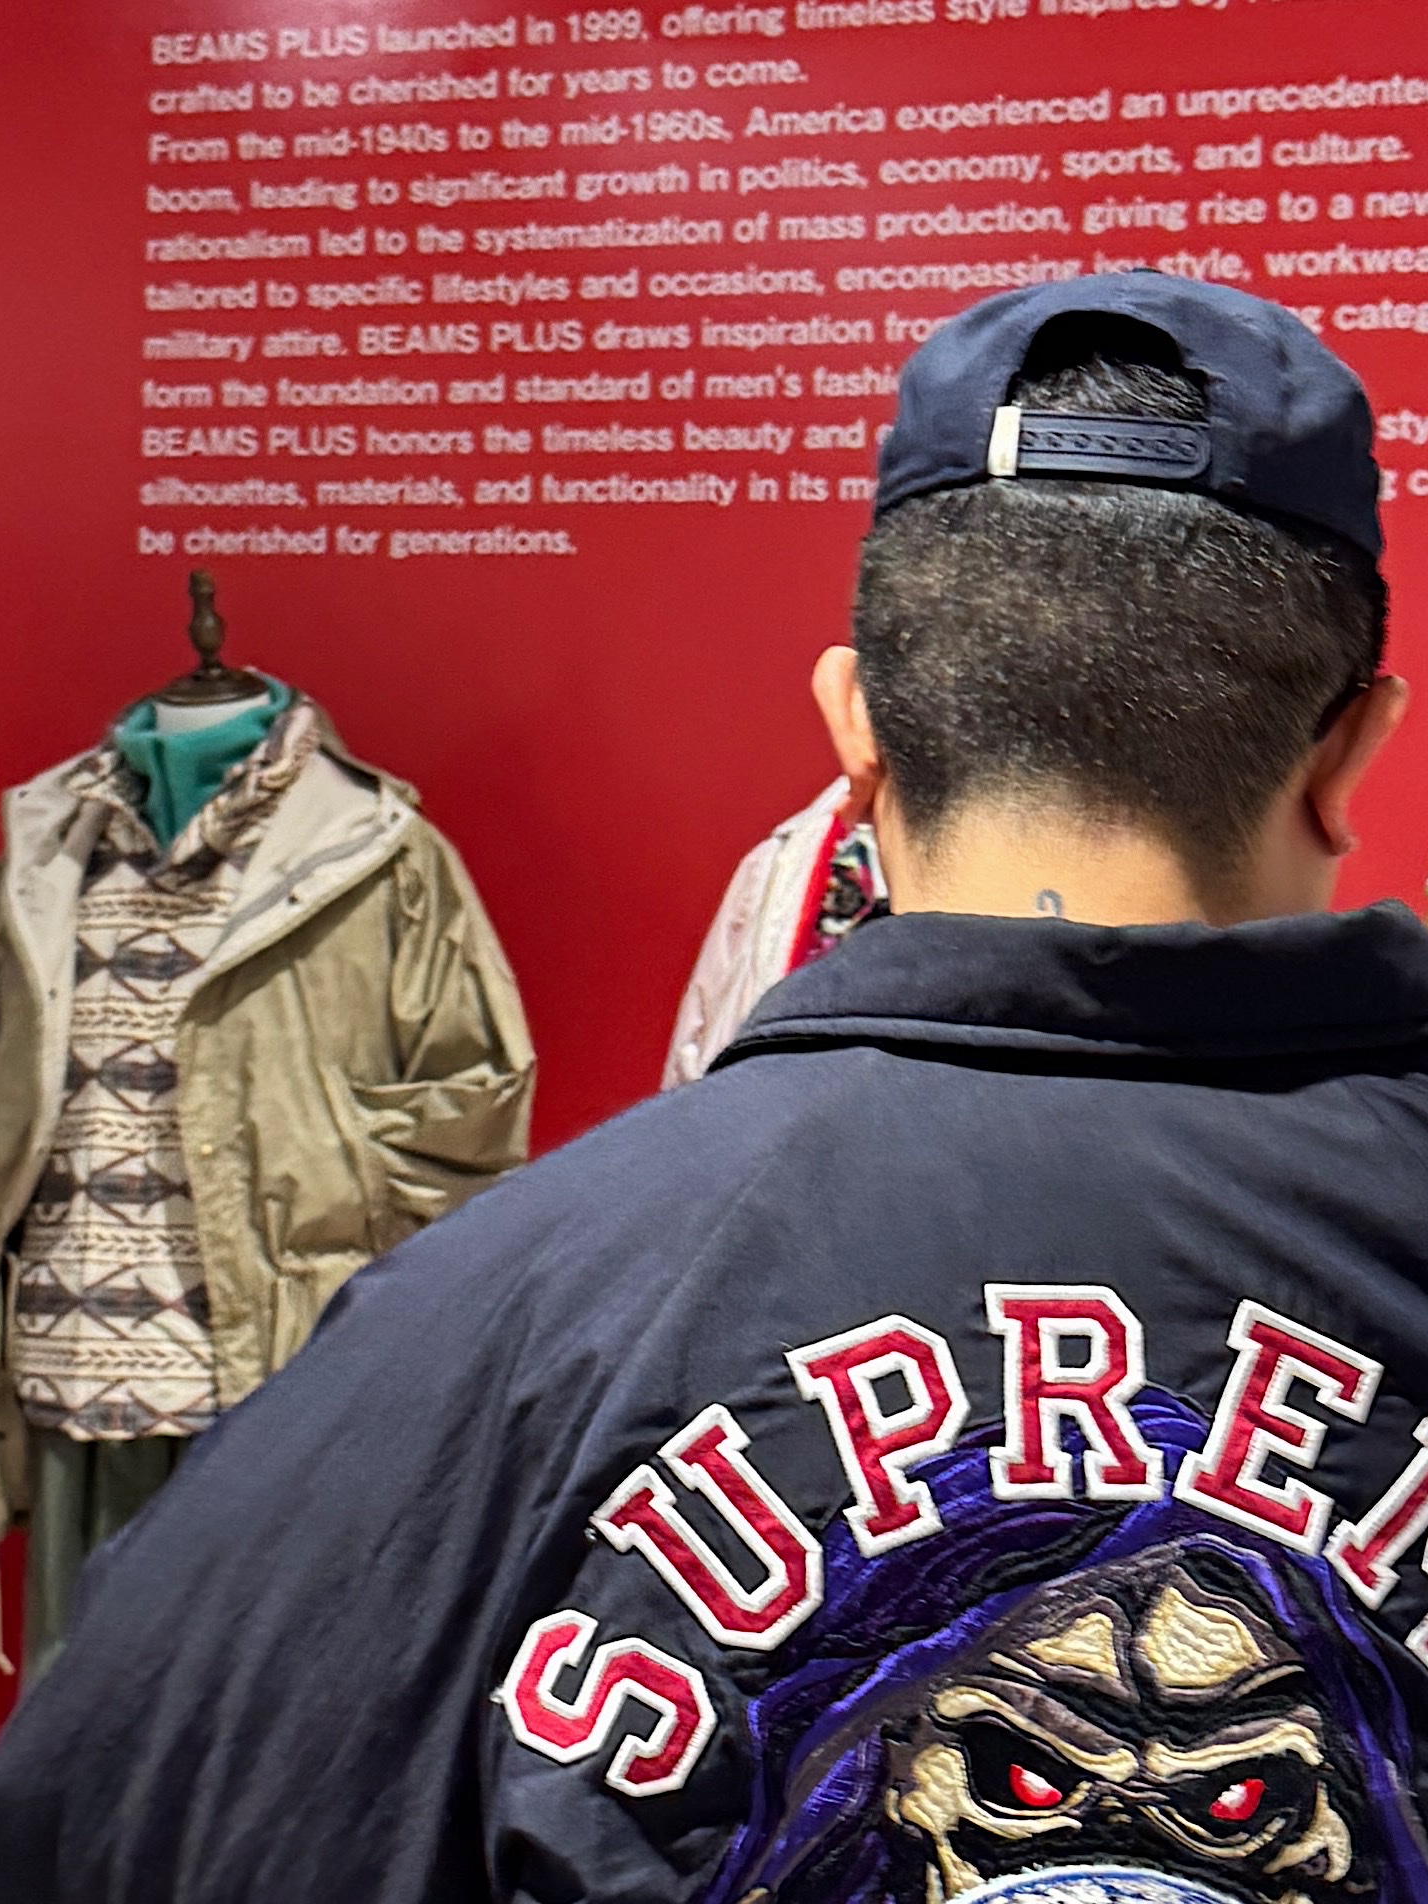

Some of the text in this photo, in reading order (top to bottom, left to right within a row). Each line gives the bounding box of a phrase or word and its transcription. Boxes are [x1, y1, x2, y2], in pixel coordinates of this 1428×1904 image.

[152, 31, 266, 65] BEAMS
[279, 25, 366, 57] PLUS
[378, 17, 516, 51] launched
[526, 16, 555, 45] in
[567, 9, 648, 42] 1999,
[662, 4, 785, 37] offering
[149, 59, 807, 114] crafted to be cherished for years to come.
[149, 133, 229, 162] From
[237, 133, 284, 159] the
[295, 124, 448, 156] mid-1940s
[458, 124, 491, 150] to
[501, 119, 550, 149] the
[561, 110, 732, 144] mid-1960s,
[744, 104, 886, 136] America
[895, 89, 1111, 131] experienced
[1120, 92, 1166, 120] an
[147, 186, 239, 213] boom,
[250, 179, 357, 210] leading
[368, 178, 399, 205] to
[409, 170, 565, 207] significant
[576, 165, 689, 201] growth
[699, 162, 729, 191] in
[739, 158, 868, 193] politics,
[879, 155, 1049, 184] economy,
[1063, 144, 1182, 180] sports,
[1194, 136, 1262, 171] and
[1272, 134, 1412, 167] culture.
[146, 231, 310, 261] rationalism
[320, 227, 365, 256] led
[375, 227, 407, 254] to
[417, 224, 464, 253] the
[475, 218, 722, 254] systematization
[733, 211, 769, 243] of
[779, 215, 866, 240] mass
[877, 203, 1070, 241] production,
[1083, 197, 1188, 235] giving
[1198, 192, 1267, 224] rise
[1278, 191, 1318, 222] to
[1328, 193, 1354, 220] a
[145, 281, 257, 310] tailored
[266, 281, 297, 308] to
[307, 276, 421, 309] specific
[434, 274, 570, 305] lifestyles
[580, 269, 638, 299] and
[649, 267, 824, 297] occasions,
[835, 253, 1082, 289] encompassing
[1156, 248, 1251, 280] style,
[144, 331, 252, 361] military
[263, 330, 347, 358] attire.
[360, 323, 479, 355] BEAMS
[491, 319, 583, 352] PLUS
[593, 320, 691, 350] draws
[702, 316, 873, 348] inspiration
[142, 380, 211, 408] form
[222, 380, 267, 407] the
[278, 378, 439, 406] foundation
[448, 374, 504, 404] and
[515, 372, 650, 403] standard
[660, 369, 694, 400] of
[705, 366, 802, 399] men's
[142, 426, 258, 457] BEAMS
[269, 425, 357, 456] PLUS
[367, 428, 474, 454] honors
[483, 425, 531, 454] the
[542, 424, 674, 452] timeless
[683, 422, 793, 454] beauty
[804, 420, 865, 449] and
[140, 477, 306, 505] silhouettes,
[317, 476, 463, 505] materials,
[475, 475, 531, 504] and
[542, 473, 737, 506] functionality
[748, 472, 779, 502] in
[789, 472, 829, 501] its
[138, 525, 576, 559] be cherished for generations.
